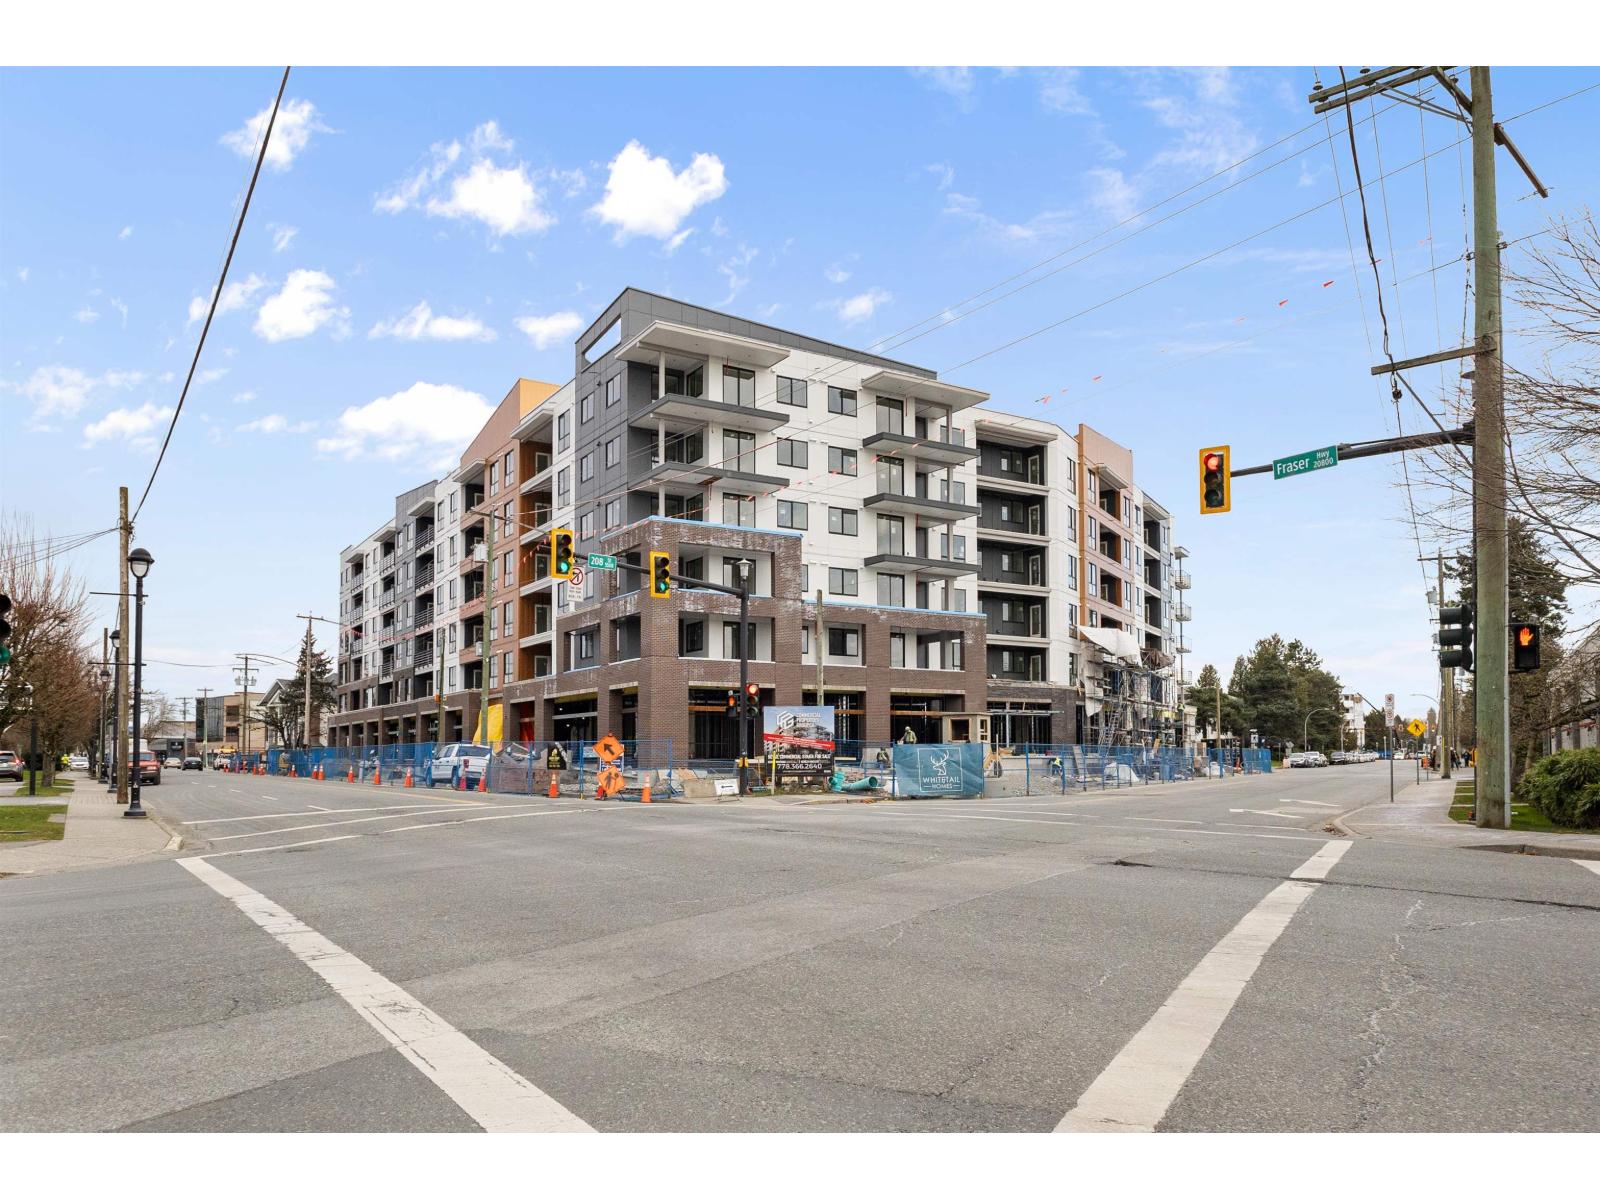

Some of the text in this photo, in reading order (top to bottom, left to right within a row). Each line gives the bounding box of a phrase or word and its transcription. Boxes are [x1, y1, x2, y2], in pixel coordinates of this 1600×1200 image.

[1316, 450, 1330, 459] Hwy
[1277, 458, 1310, 475] Fraser
[590, 556, 604, 566] 208
[922, 776, 960, 784] WHITETAIL
